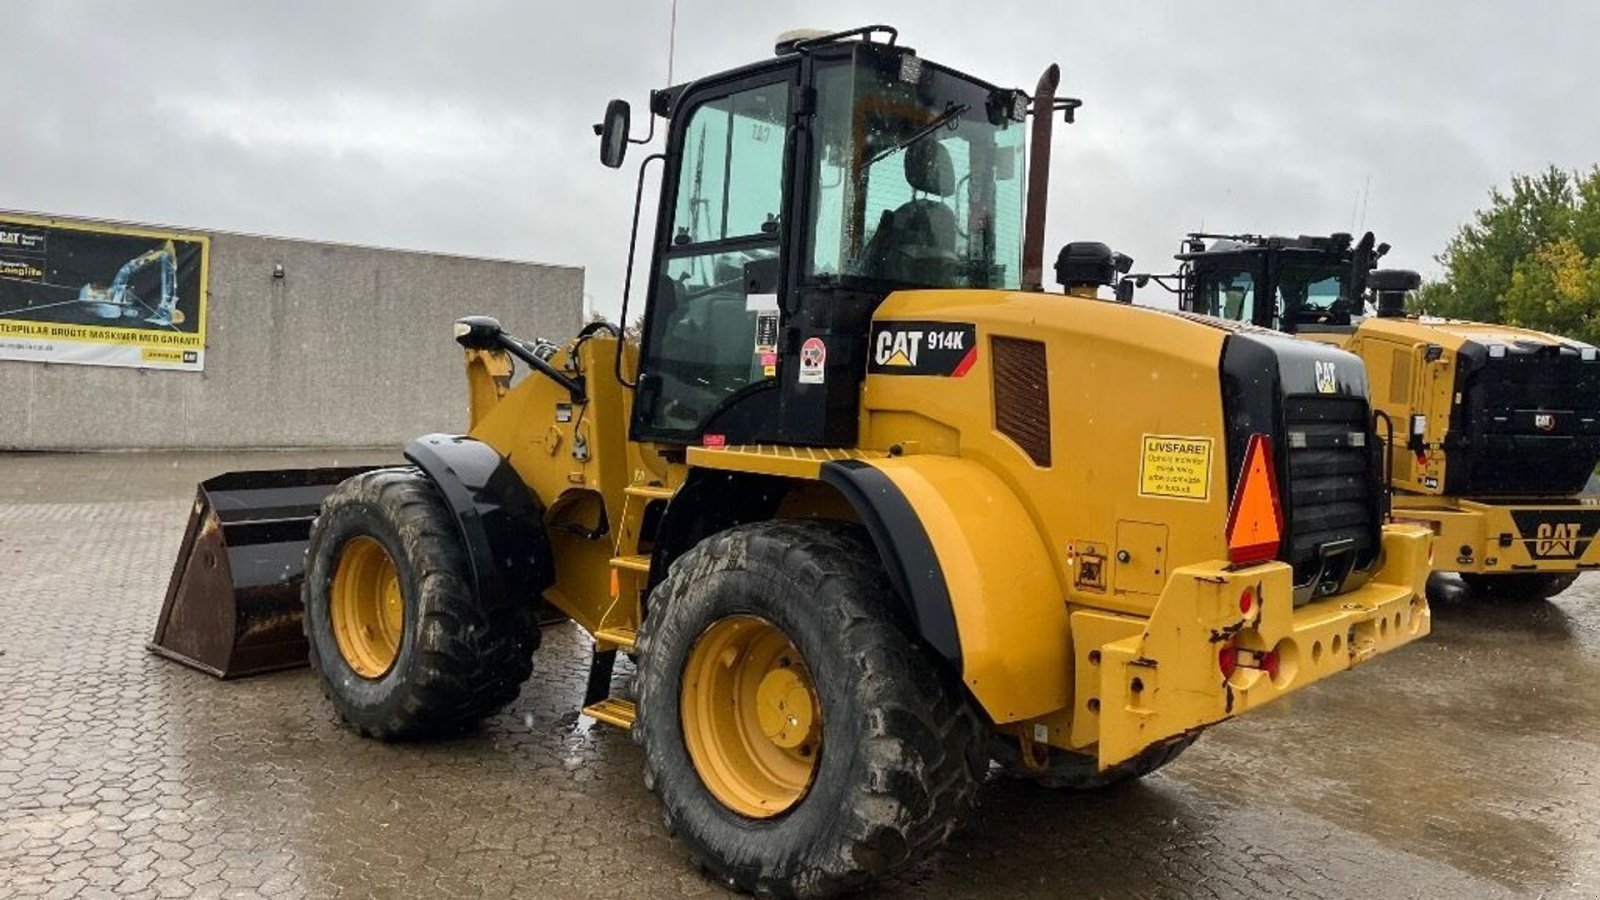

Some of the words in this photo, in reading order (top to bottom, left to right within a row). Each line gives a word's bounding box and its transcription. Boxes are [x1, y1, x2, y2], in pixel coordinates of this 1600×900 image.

[0, 231, 20, 244] CAT
[51, 327, 87, 338] BRUGTE
[139, 333, 159, 343] MED
[161, 335, 200, 345] GARANTI
[875, 330, 923, 366] CAT
[928, 331, 965, 350] 914K
[1315, 360, 1336, 394] CAT
[1535, 414, 1551, 429] CAT
[1148, 442, 1206, 455] LIVSFARE!
[1537, 523, 1581, 556] CAT
